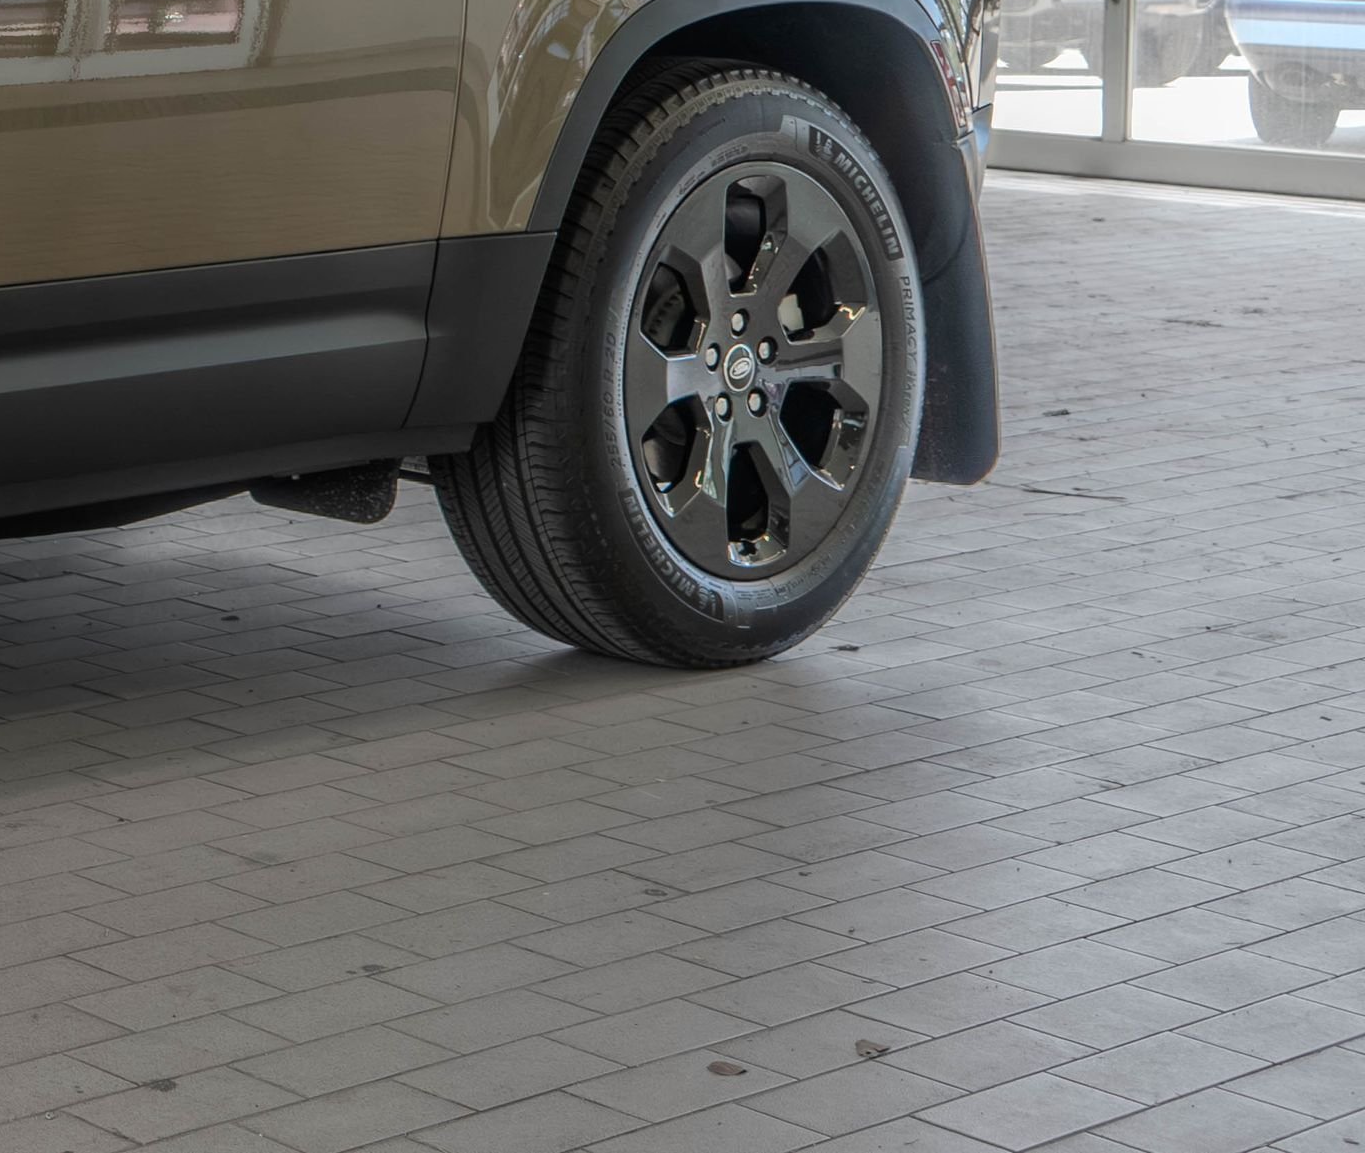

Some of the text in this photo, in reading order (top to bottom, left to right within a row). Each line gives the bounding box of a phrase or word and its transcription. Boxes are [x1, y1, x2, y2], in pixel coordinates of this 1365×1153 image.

[834, 152, 900, 255] MICHELIN
[603, 390, 622, 468] 255/60
[623, 495, 696, 597] MICHELIN
